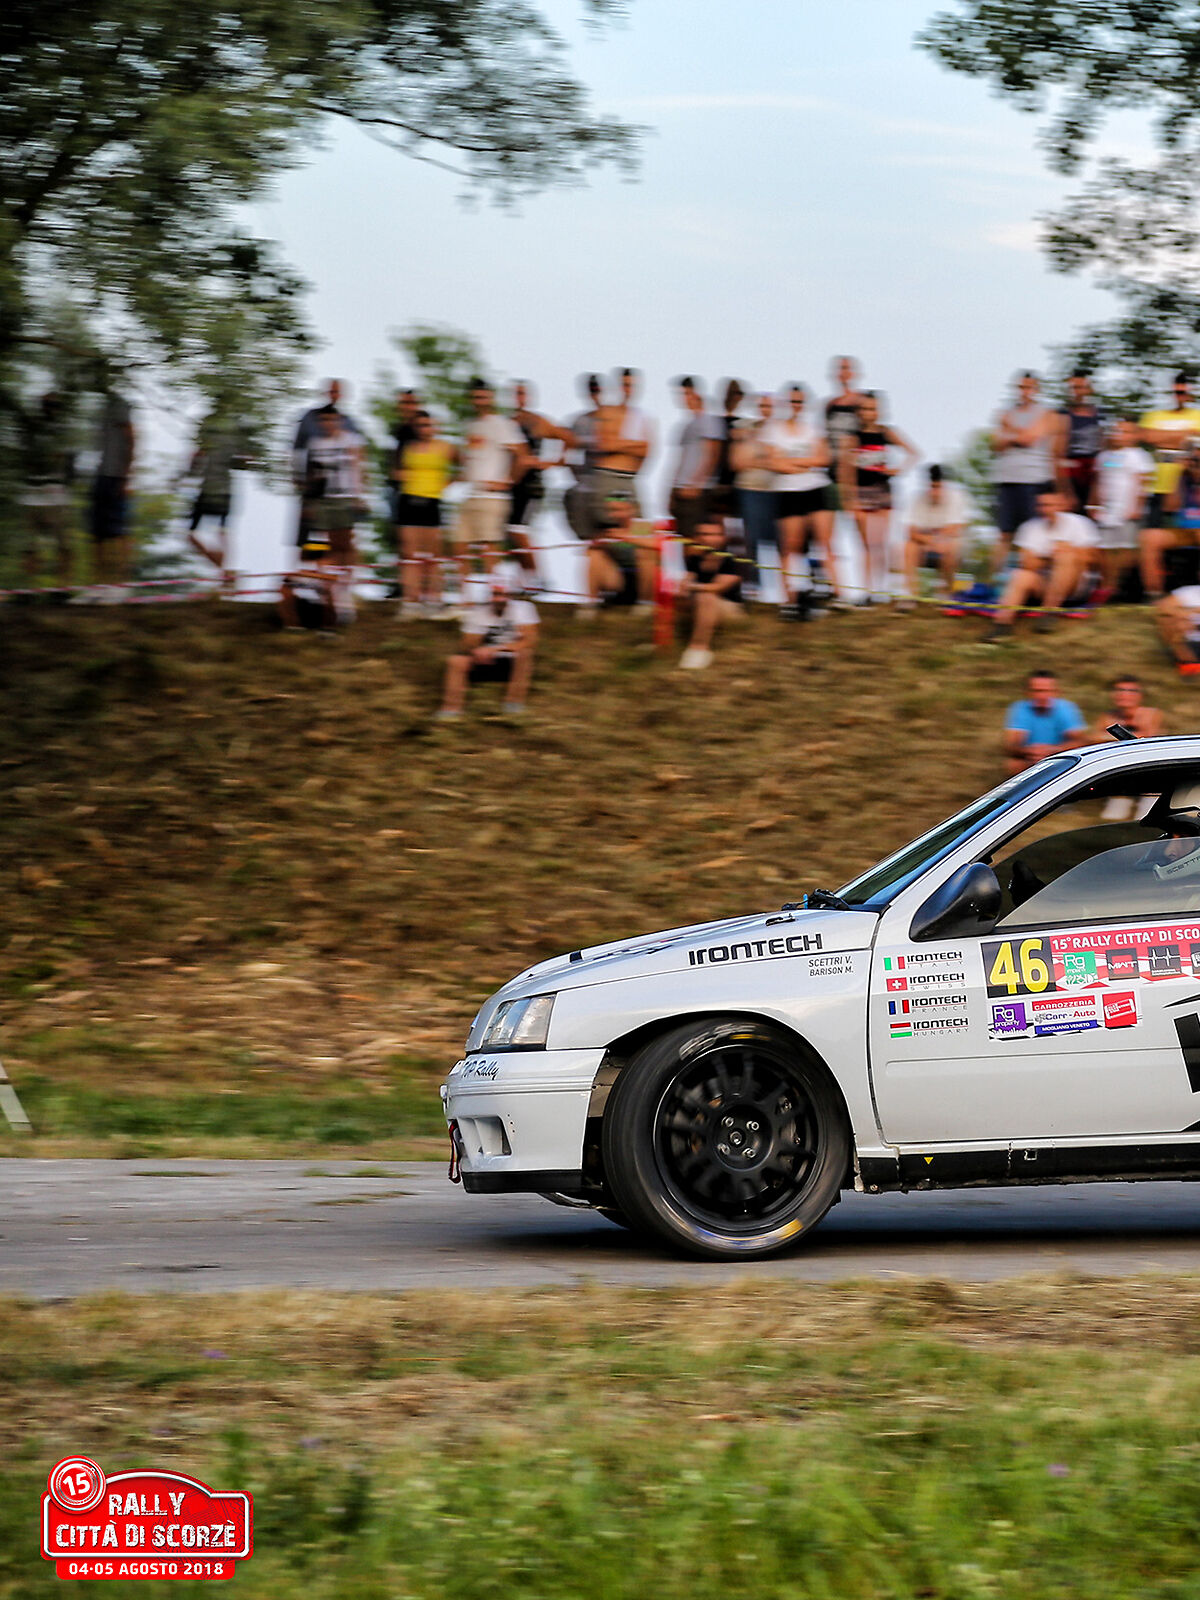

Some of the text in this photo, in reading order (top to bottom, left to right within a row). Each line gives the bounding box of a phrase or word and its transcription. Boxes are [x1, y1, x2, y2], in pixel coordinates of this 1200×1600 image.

[1073, 934, 1112, 949] RALLY
[1115, 931, 1155, 945] CITTA'
[1159, 929, 1172, 941] DI
[808, 956, 853, 968] SCETTRI V.
[908, 961, 963, 969] ITALY
[989, 938, 1049, 994] 46
[1064, 954, 1086, 969] Rg
[809, 966, 854, 977] BARISON M.
[911, 983, 966, 991] SWISS
[912, 1005, 967, 1014] FRANCE
[1034, 999, 1094, 1011] CARROZZERIA
[993, 1006, 1016, 1022] Rg
[914, 1027, 969, 1037] HUNGARY
